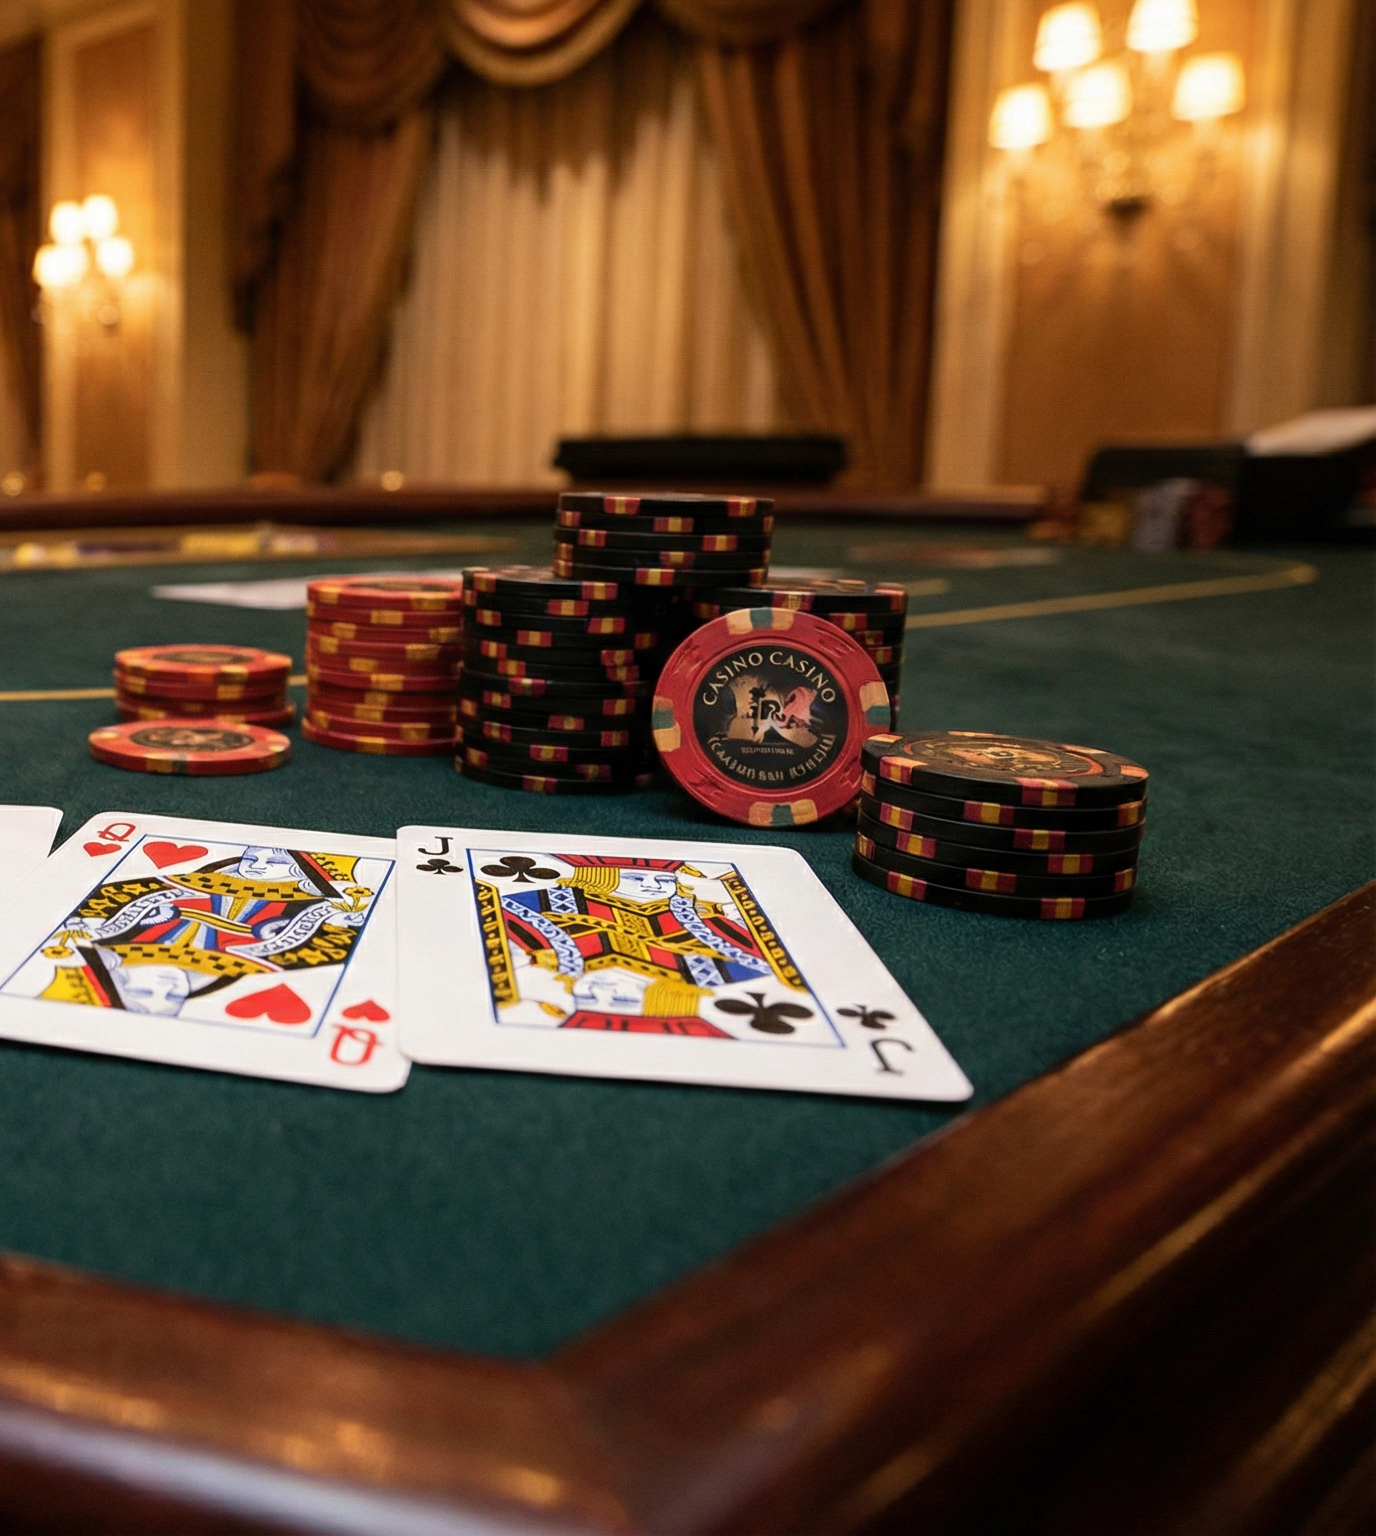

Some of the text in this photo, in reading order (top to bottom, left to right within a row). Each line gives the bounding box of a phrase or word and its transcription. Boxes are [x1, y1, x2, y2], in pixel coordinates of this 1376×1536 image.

[703, 651, 836, 706] CASINO CASINO
[97, 822, 137, 842] Q
[417, 835, 454, 856] J
[330, 1023, 384, 1067] Q
[869, 1038, 914, 1077] J
